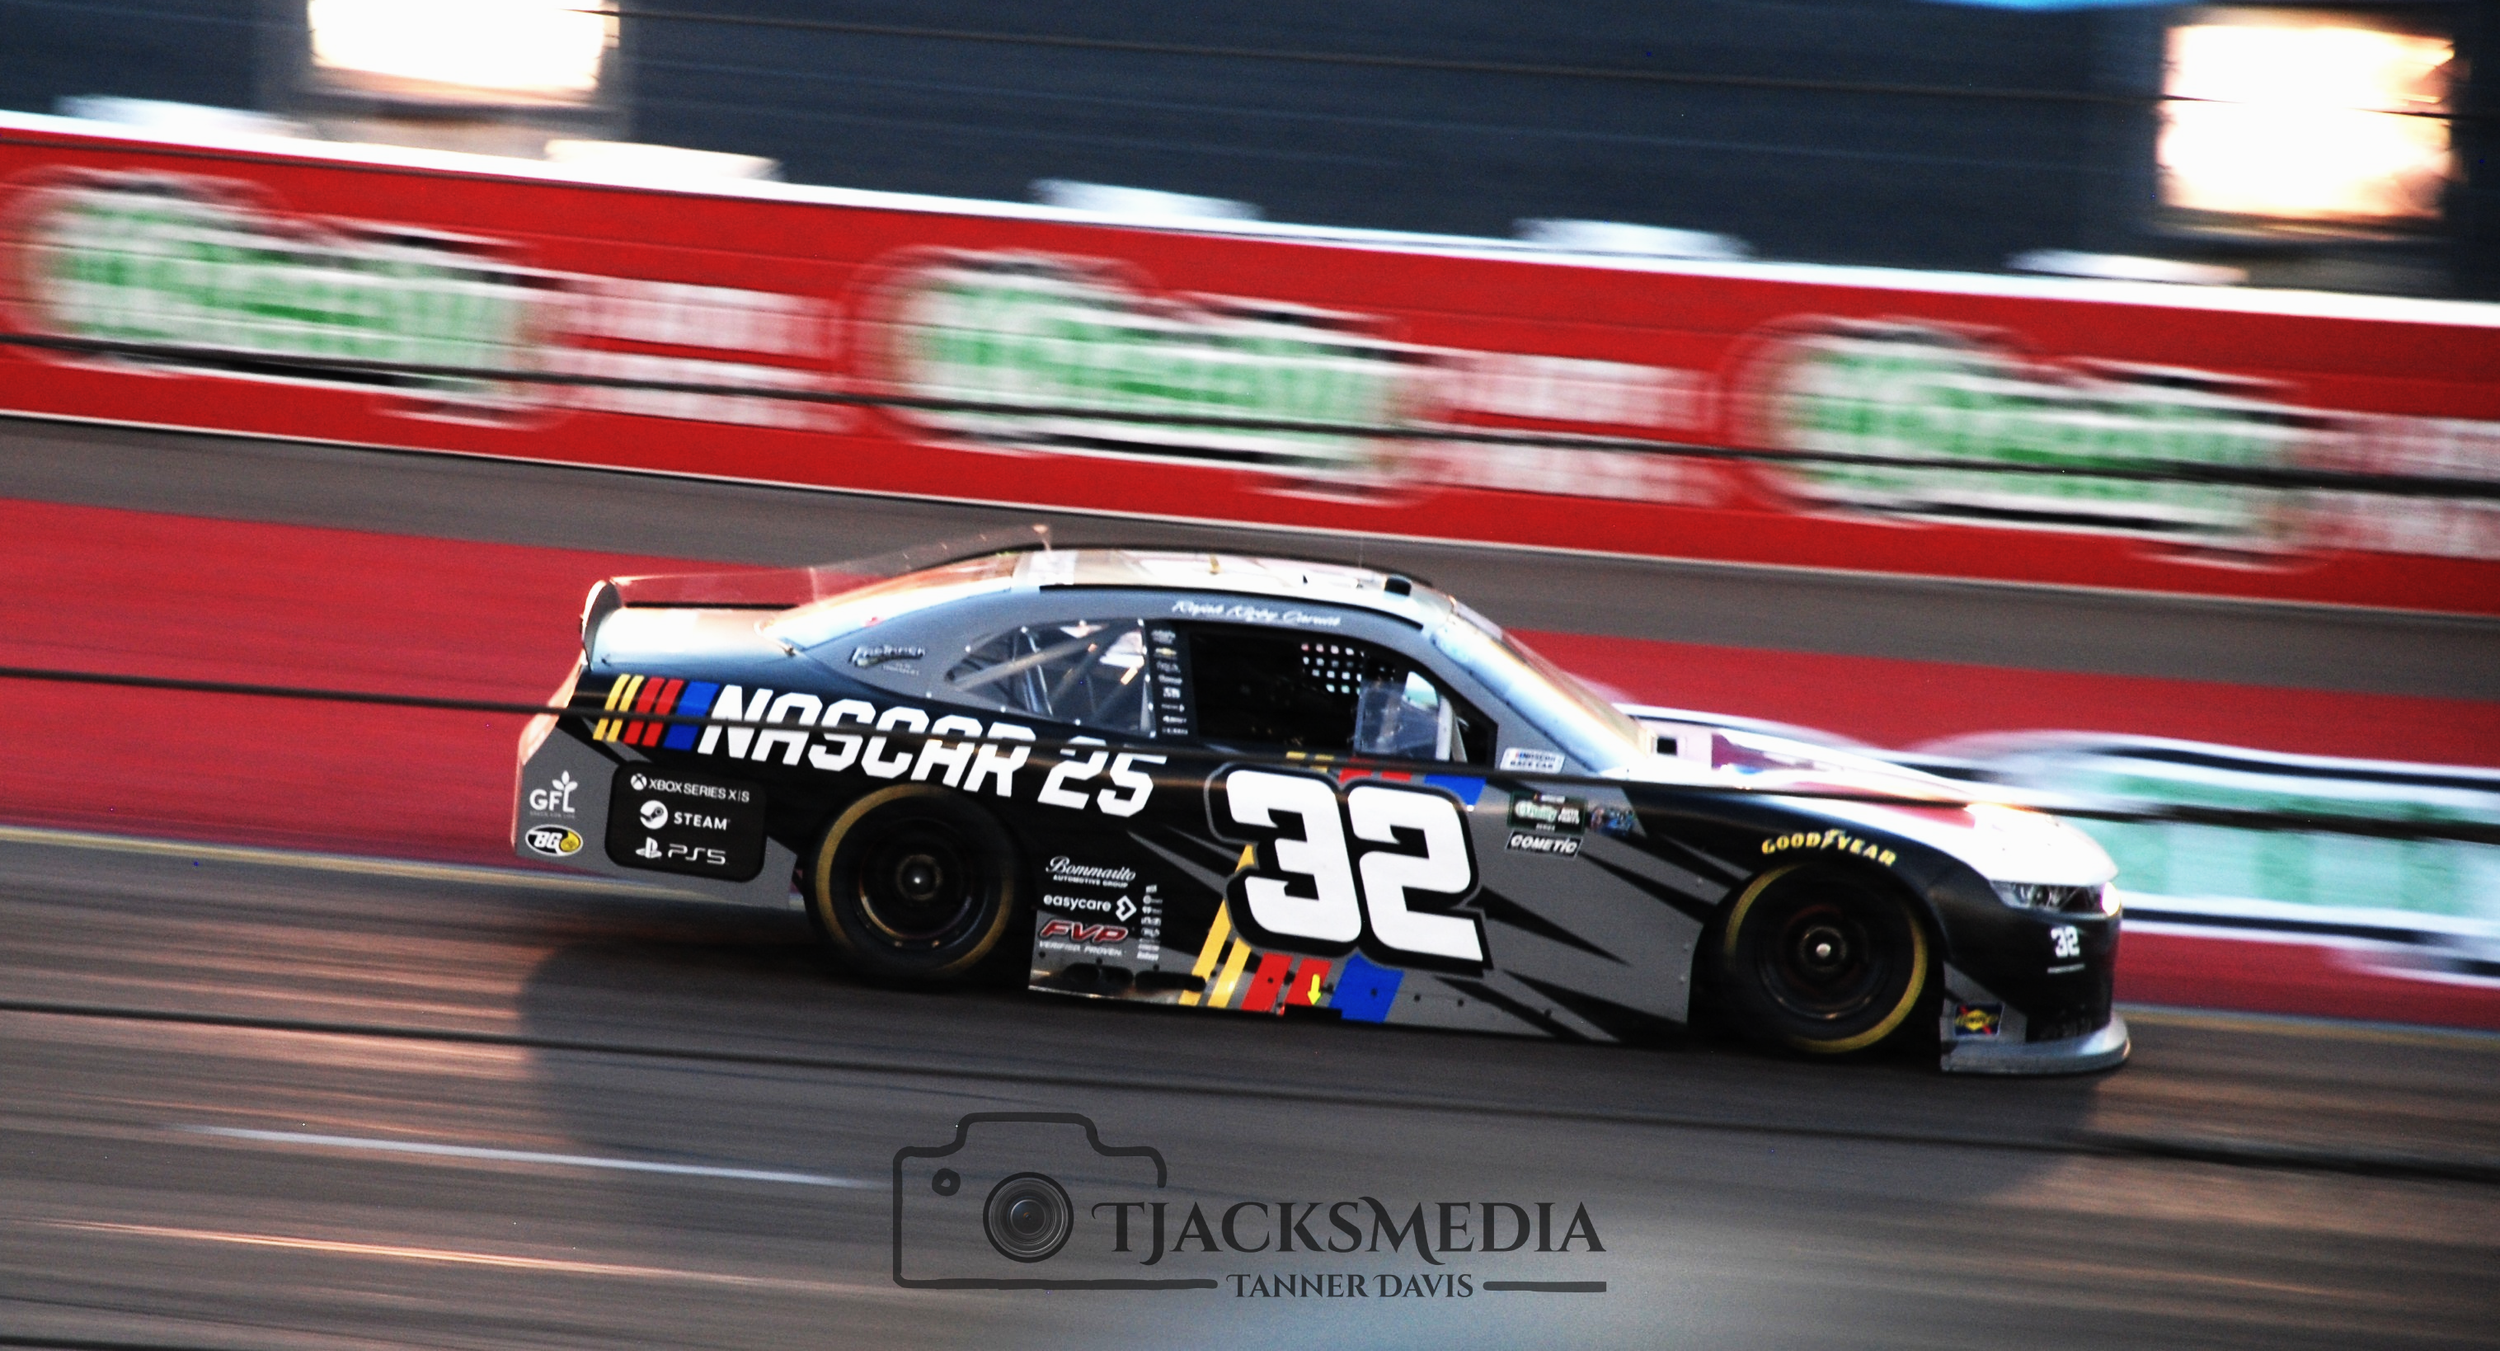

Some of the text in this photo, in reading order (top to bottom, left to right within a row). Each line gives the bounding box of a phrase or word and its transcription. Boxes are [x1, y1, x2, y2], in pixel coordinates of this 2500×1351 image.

[698, 684, 1167, 818] NASCAR 25
[529, 784, 577, 813] GFL
[649, 777, 682, 794] XBOX
[683, 781, 726, 800] SERIES
[673, 811, 728, 830] STEAM
[531, 830, 563, 850] BG
[1510, 834, 1578, 854] COMETIC
[1761, 828, 1897, 867] GOODYEAR
[667, 842, 727, 865] PS5
[1045, 855, 1137, 882] Bommarito
[1226, 769, 1483, 962] 32
[1052, 874, 1129, 889] AUTOMOTIVE GROUP
[1043, 894, 1112, 911] easycare
[1040, 920, 1129, 943] FVP
[2050, 925, 2081, 958] 32
